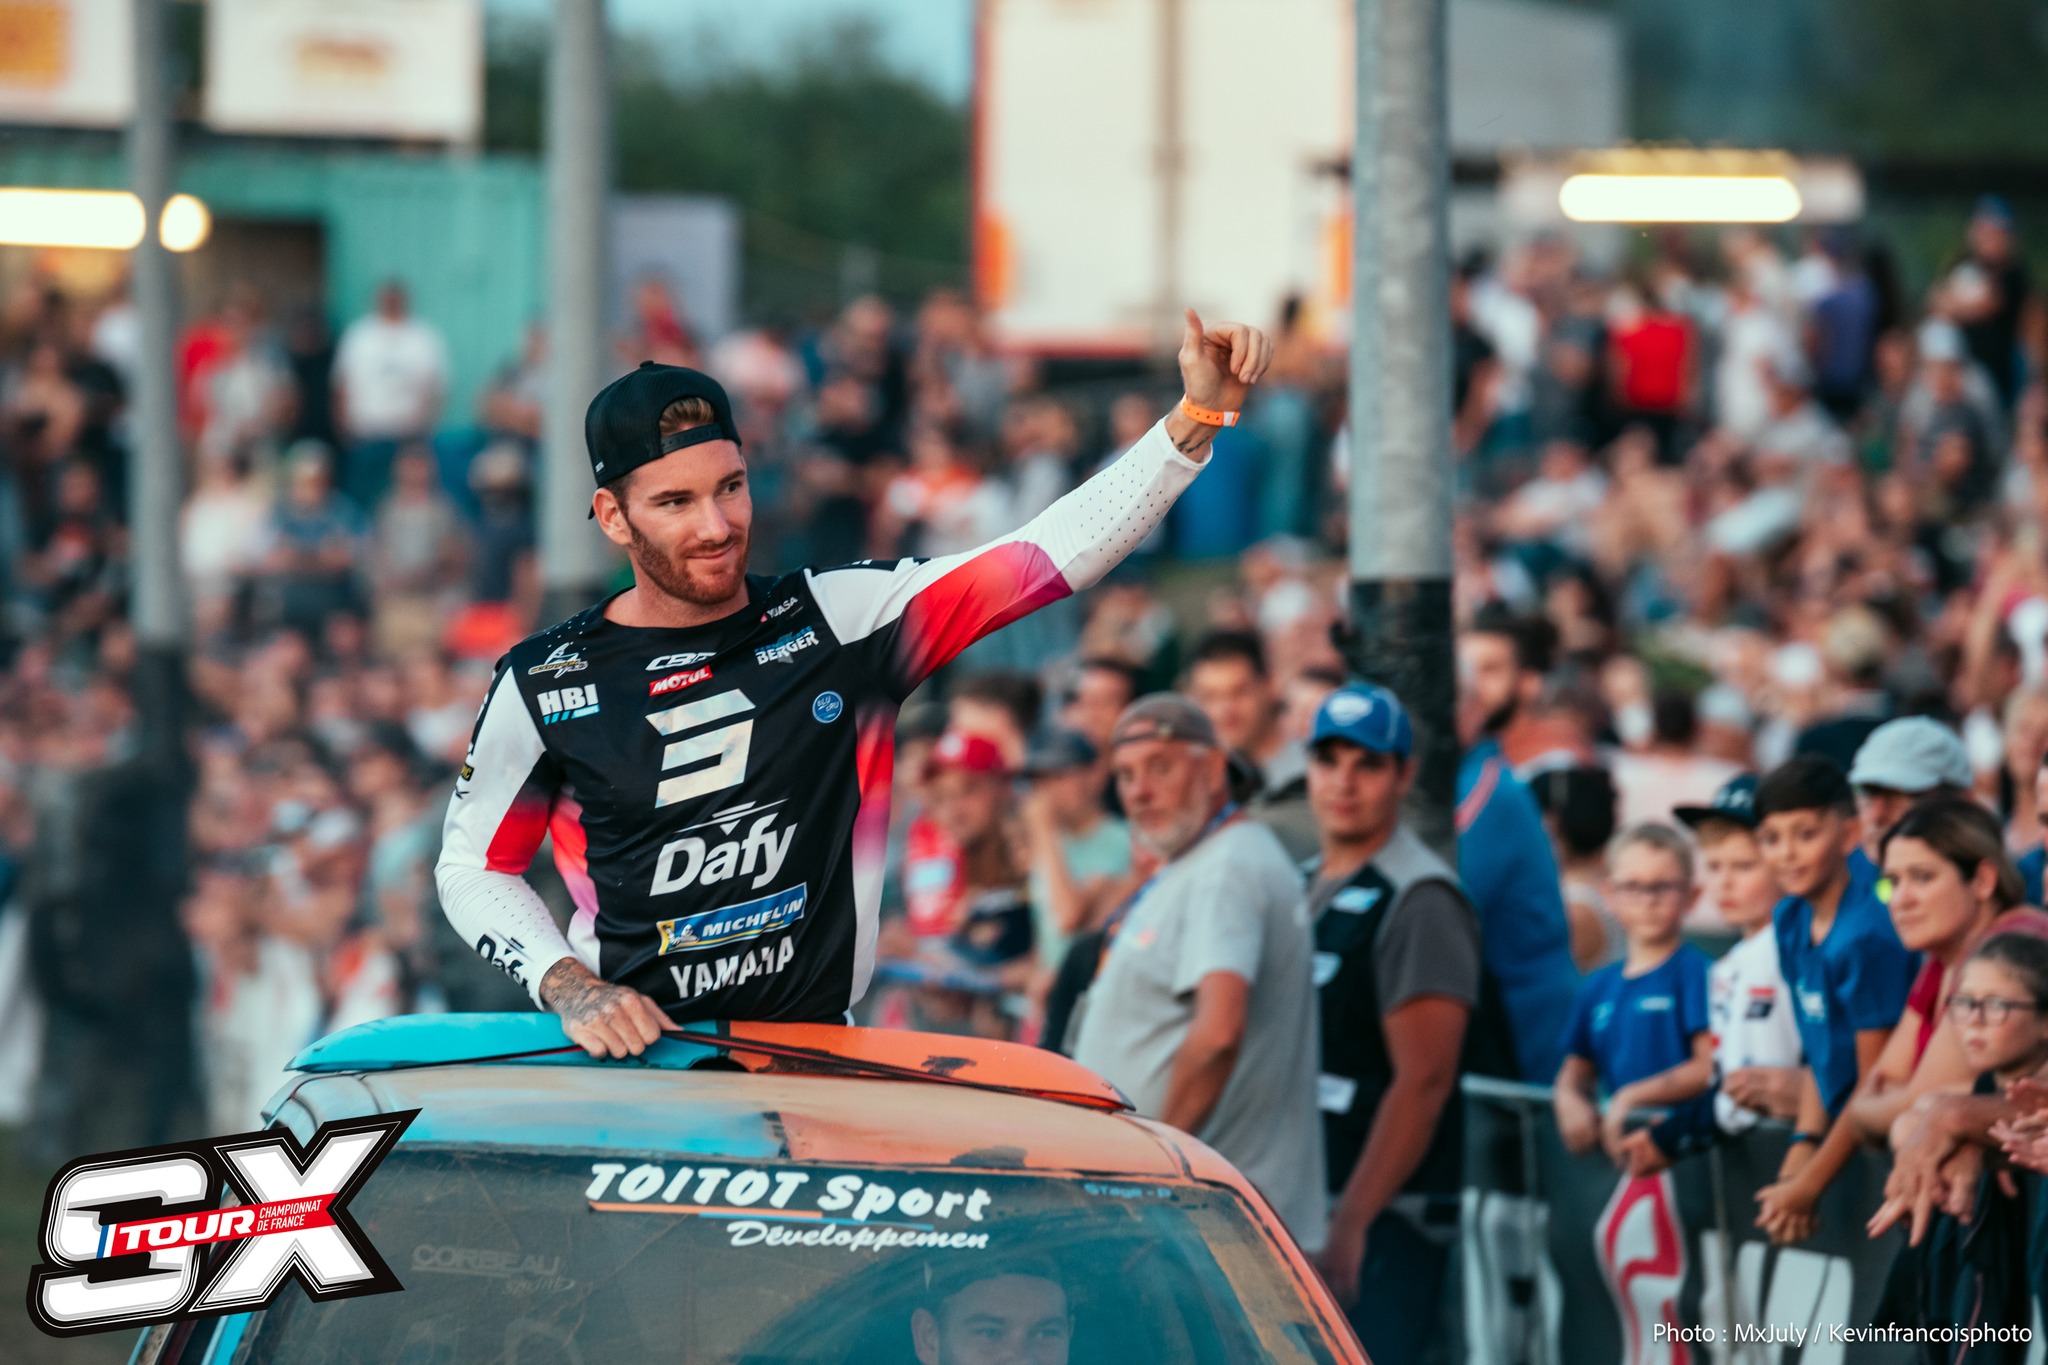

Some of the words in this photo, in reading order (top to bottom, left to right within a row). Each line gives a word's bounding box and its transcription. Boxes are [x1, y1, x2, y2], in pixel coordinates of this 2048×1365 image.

[756, 631, 819, 665] BERGER
[652, 667, 709, 693] MOTUL
[537, 684, 599, 716] HBI
[649, 812, 798, 896] Dafy
[702, 898, 803, 937] MICHELIN
[670, 936, 795, 998] YAMAHA
[585, 1164, 809, 1208] TOITOT
[817, 1175, 992, 1222] Sport
[413, 1244, 561, 1276] CORBEAU
